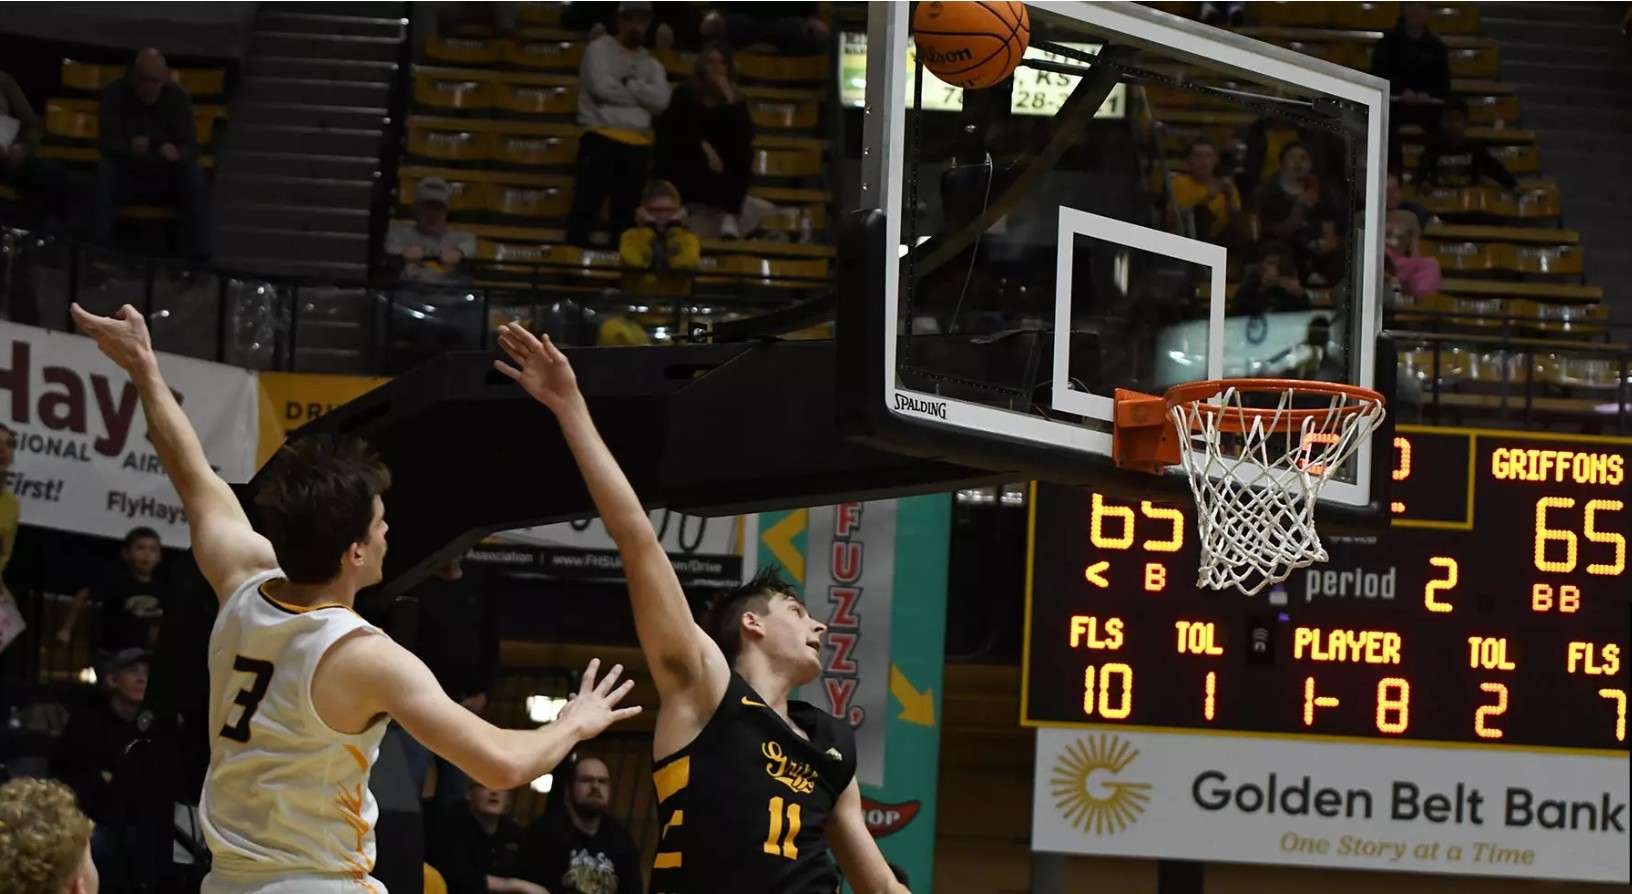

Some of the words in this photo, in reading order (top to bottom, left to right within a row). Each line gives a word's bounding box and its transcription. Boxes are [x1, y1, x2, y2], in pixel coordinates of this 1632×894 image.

[0, 340, 184, 457] Hay
[894, 392, 947, 420] SPALDING
[1492, 447, 1625, 486] GRIFFONS
[1090, 493, 1184, 552] 65
[1535, 496, 1626, 576] 65
[465, 548, 534, 565] Association
[1144, 562, 1166, 592] B
[1306, 566, 1397, 602] period
[1424, 556, 1459, 613] 2
[1070, 615, 1124, 650] FLS
[1175, 621, 1224, 655] TOL
[1294, 627, 1402, 664] PLAYER
[1468, 636, 1516, 670] TOL
[1567, 641, 1621, 676] FLS
[219, 655, 274, 744] 3
[1083, 662, 1133, 719] 10
[1204, 671, 1217, 721] 1
[1376, 677, 1410, 734] 8
[1474, 682, 1508, 738] 2
[1598, 688, 1627, 742] 7
[861, 808, 901, 826] OP
[1192, 769, 1374, 820] Golden
[1391, 780, 1485, 825] Belt
[1504, 786, 1626, 833] Bank
[763, 795, 802, 861] 11
[1279, 831, 1330, 855] One
[1336, 834, 1408, 863] Story
[1412, 839, 1440, 861] at
[1446, 844, 1464, 862] a
[1471, 841, 1537, 866] Time
